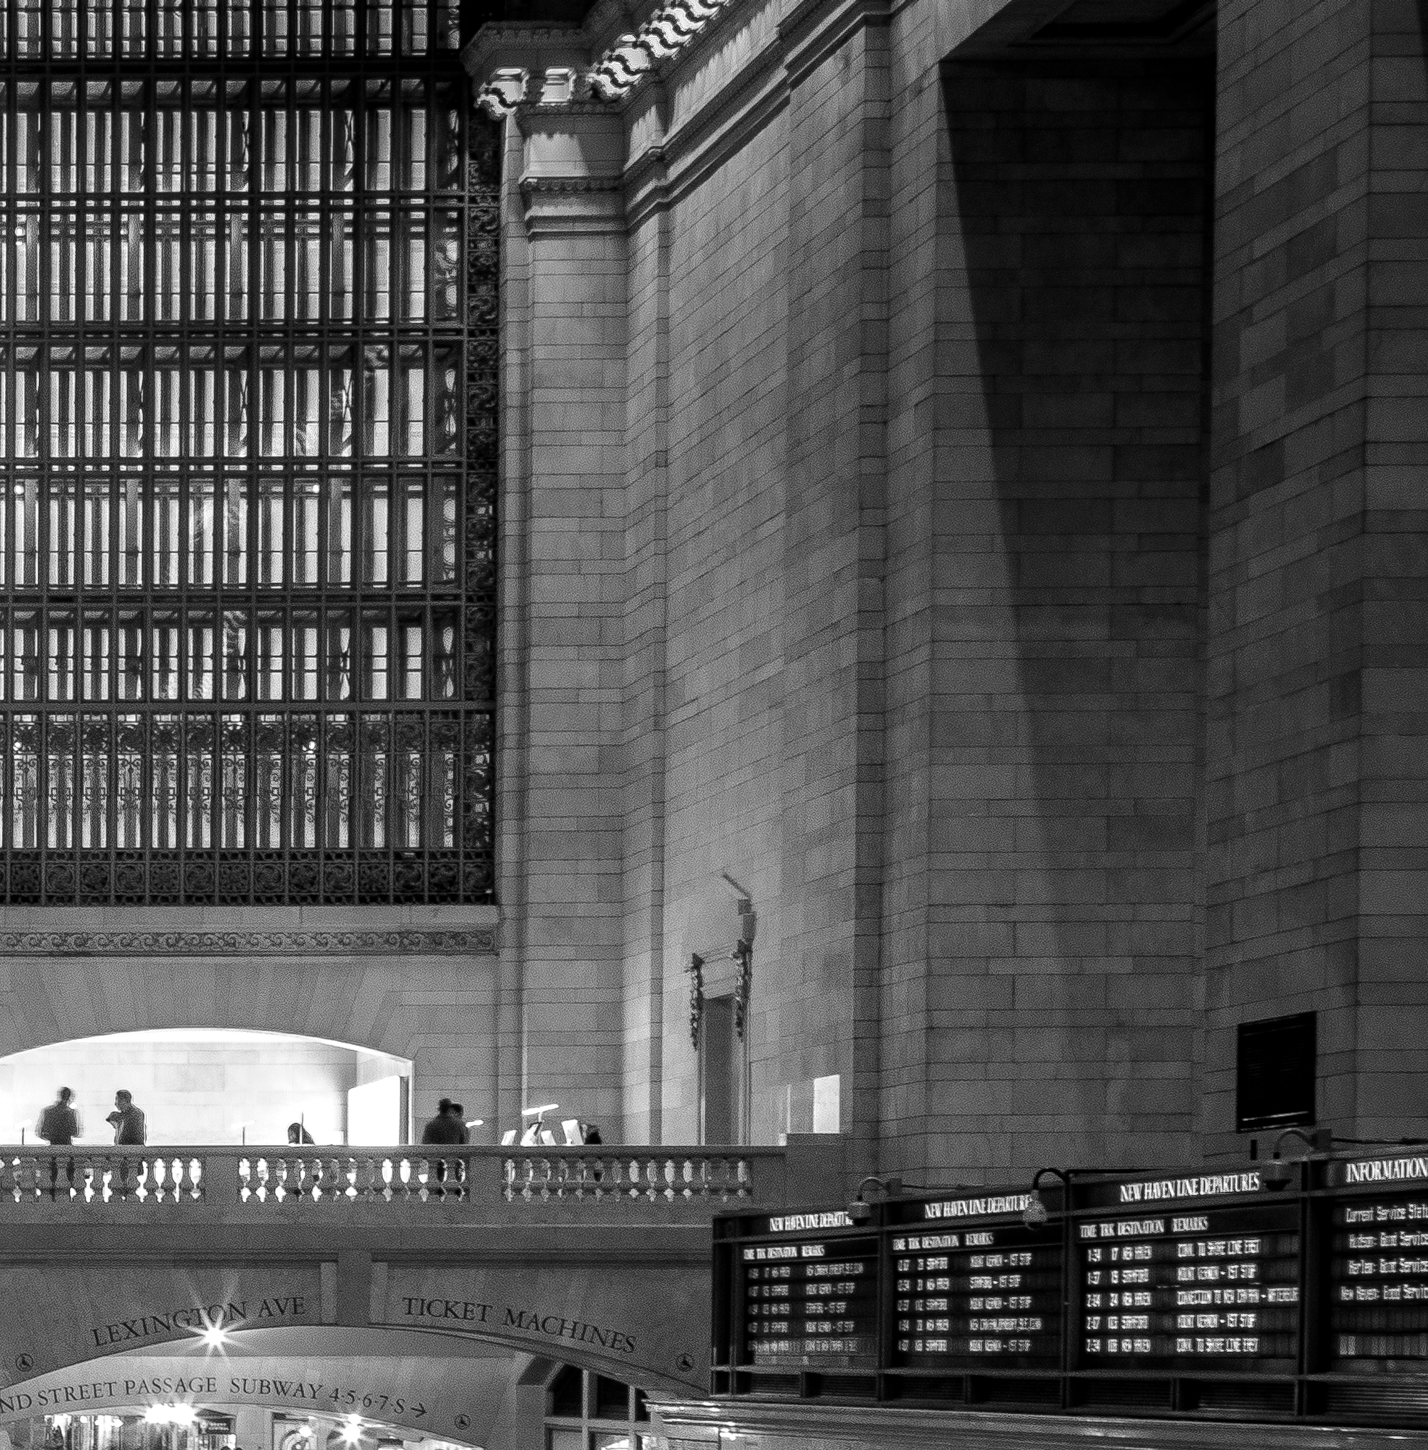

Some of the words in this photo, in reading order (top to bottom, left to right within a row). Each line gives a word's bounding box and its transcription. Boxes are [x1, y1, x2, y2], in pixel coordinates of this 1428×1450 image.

[1346, 1158, 1428, 1183] INFORMATION
[1120, 1184, 1143, 1202] NEW
[1144, 1180, 1175, 1200] HAVEN
[1177, 1178, 1200, 1197] LINE
[1200, 1172, 1260, 1195] DEPARTURES
[944, 1201, 968, 1217] HAVEN
[91, 1301, 248, 1348] LEXINGTON
[257, 1296, 306, 1319] AVE
[402, 1297, 494, 1323] TICKET
[502, 1307, 637, 1354] MACHINES
[37, 1381, 117, 1406] STREET
[123, 1376, 218, 1396] PASSAGE
[229, 1376, 324, 1401] SUBWAY
